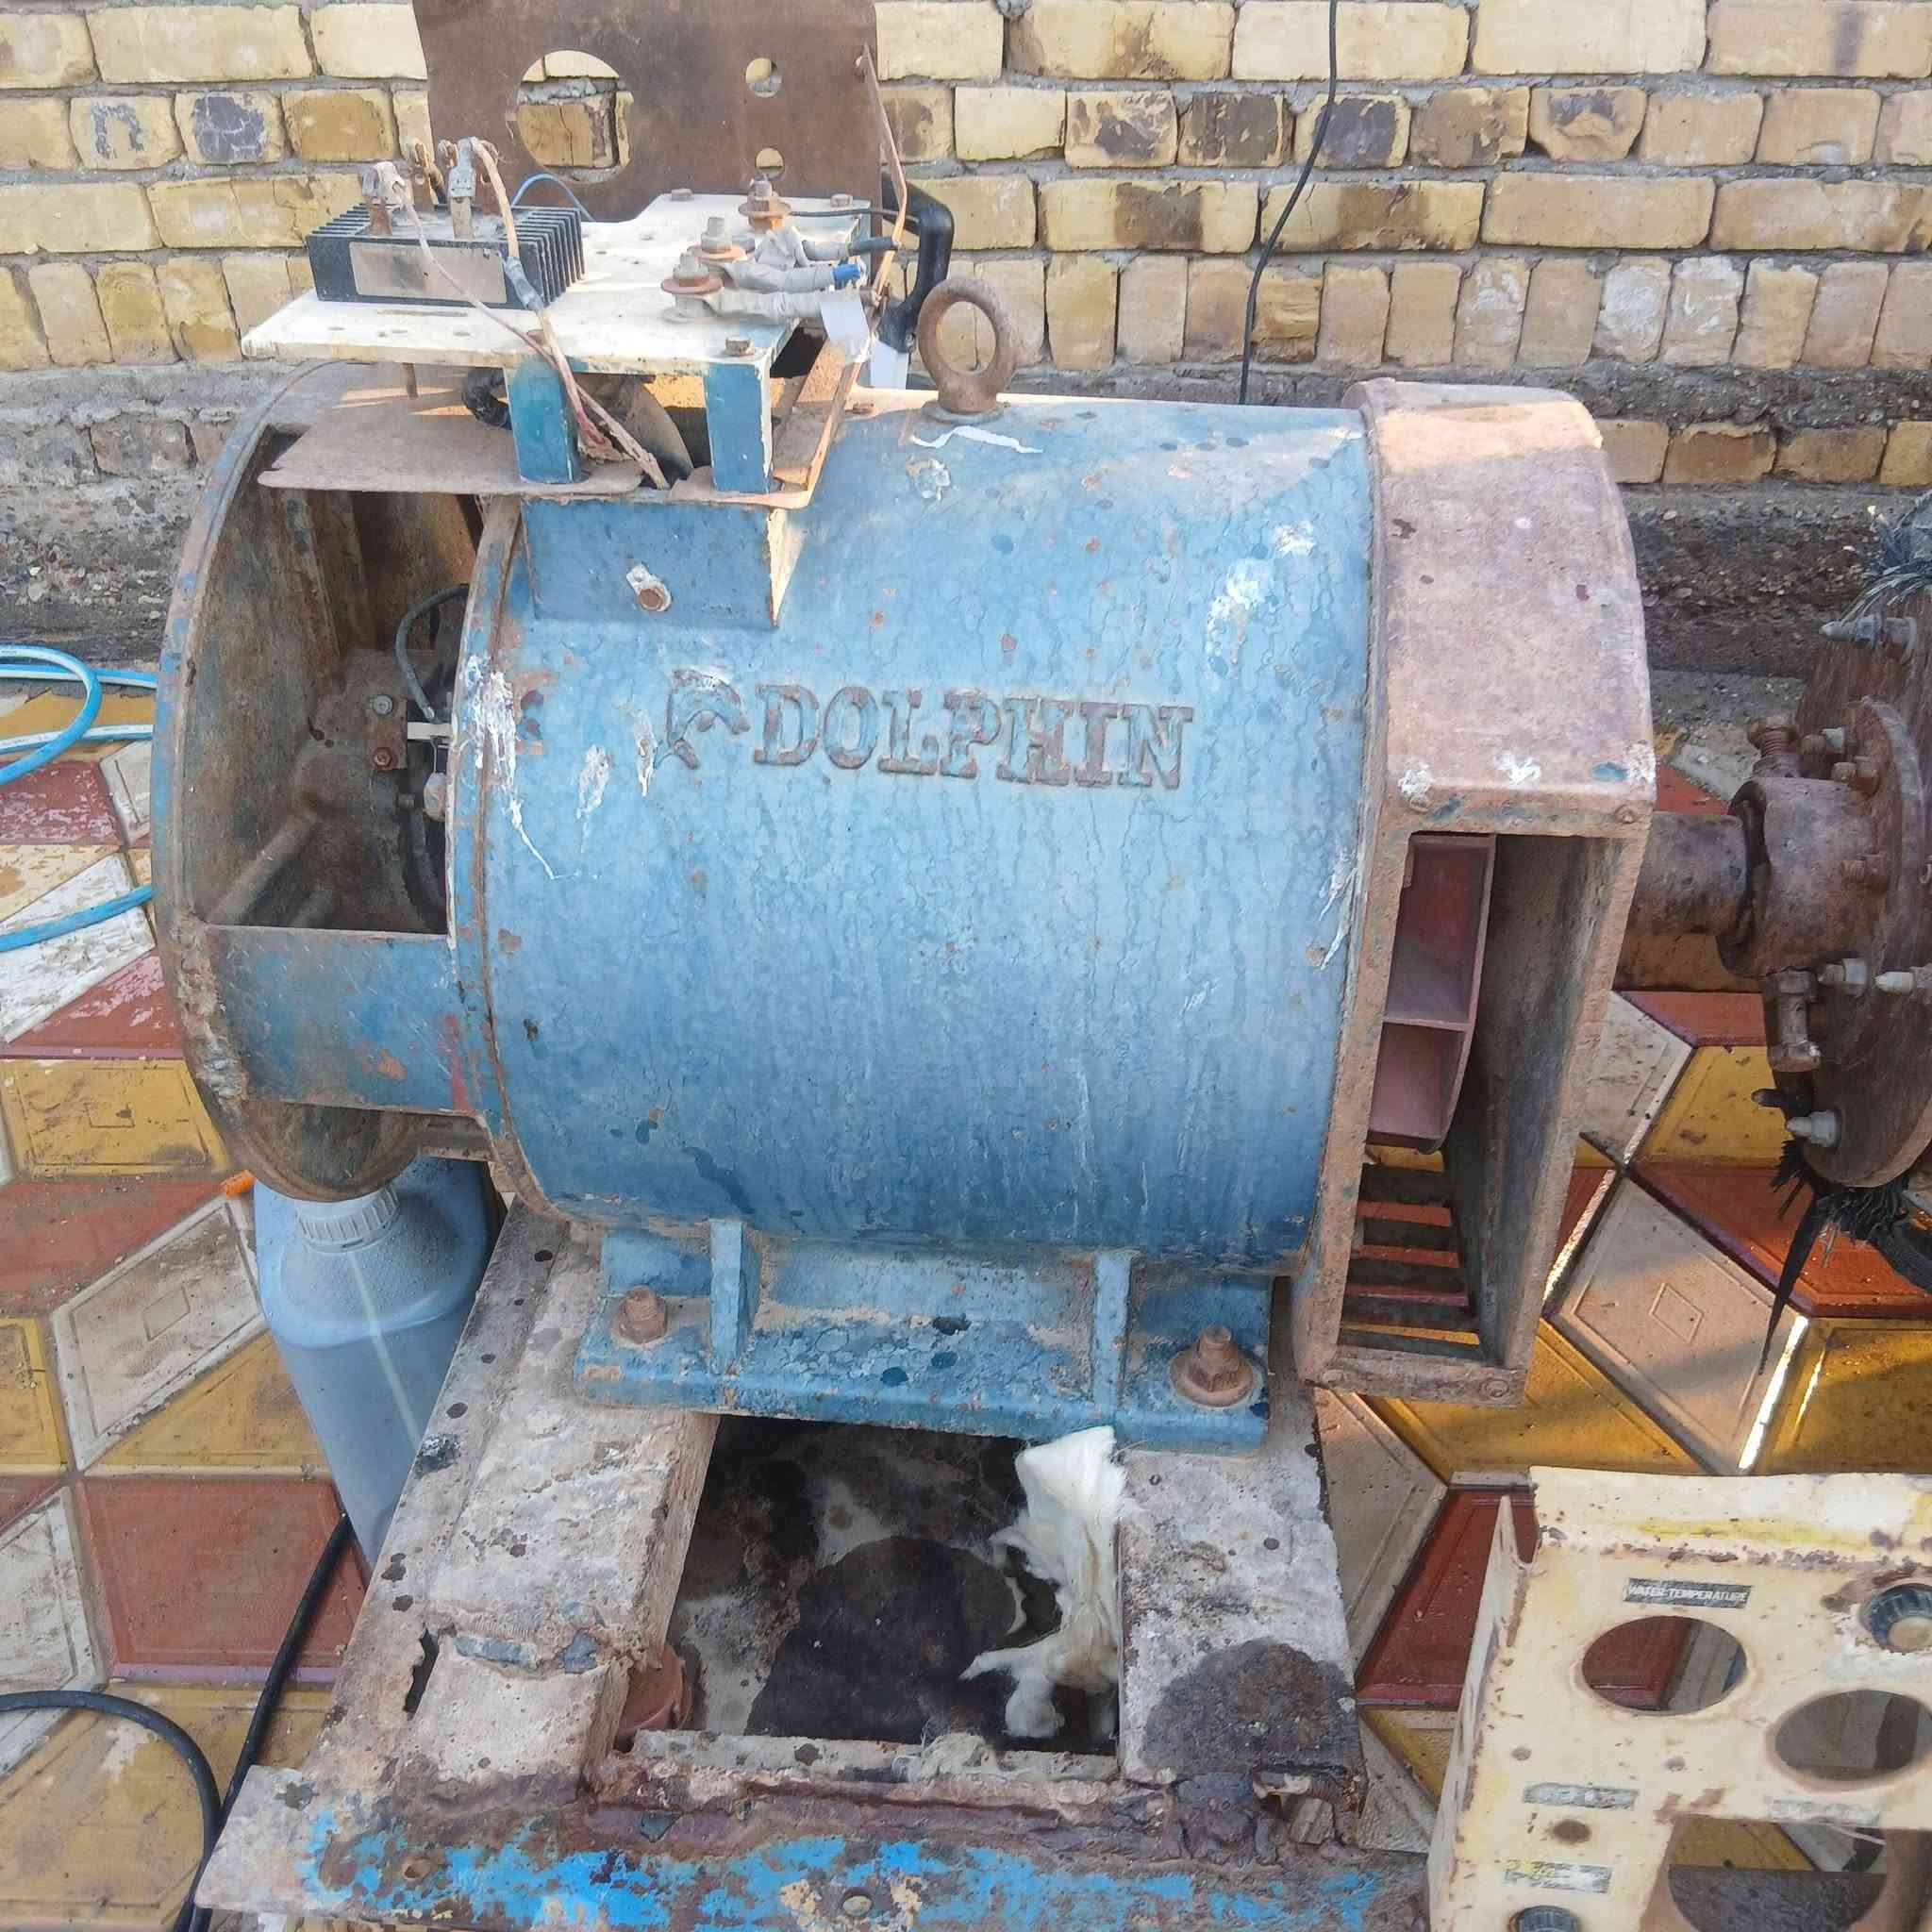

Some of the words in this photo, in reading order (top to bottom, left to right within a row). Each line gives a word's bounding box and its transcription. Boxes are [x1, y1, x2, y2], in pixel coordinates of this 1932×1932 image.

[754, 684, 1193, 790] DOLPHIN
[1628, 1585, 1668, 1598] WATER
[1669, 1588, 1748, 1602] TEMPERATURE
